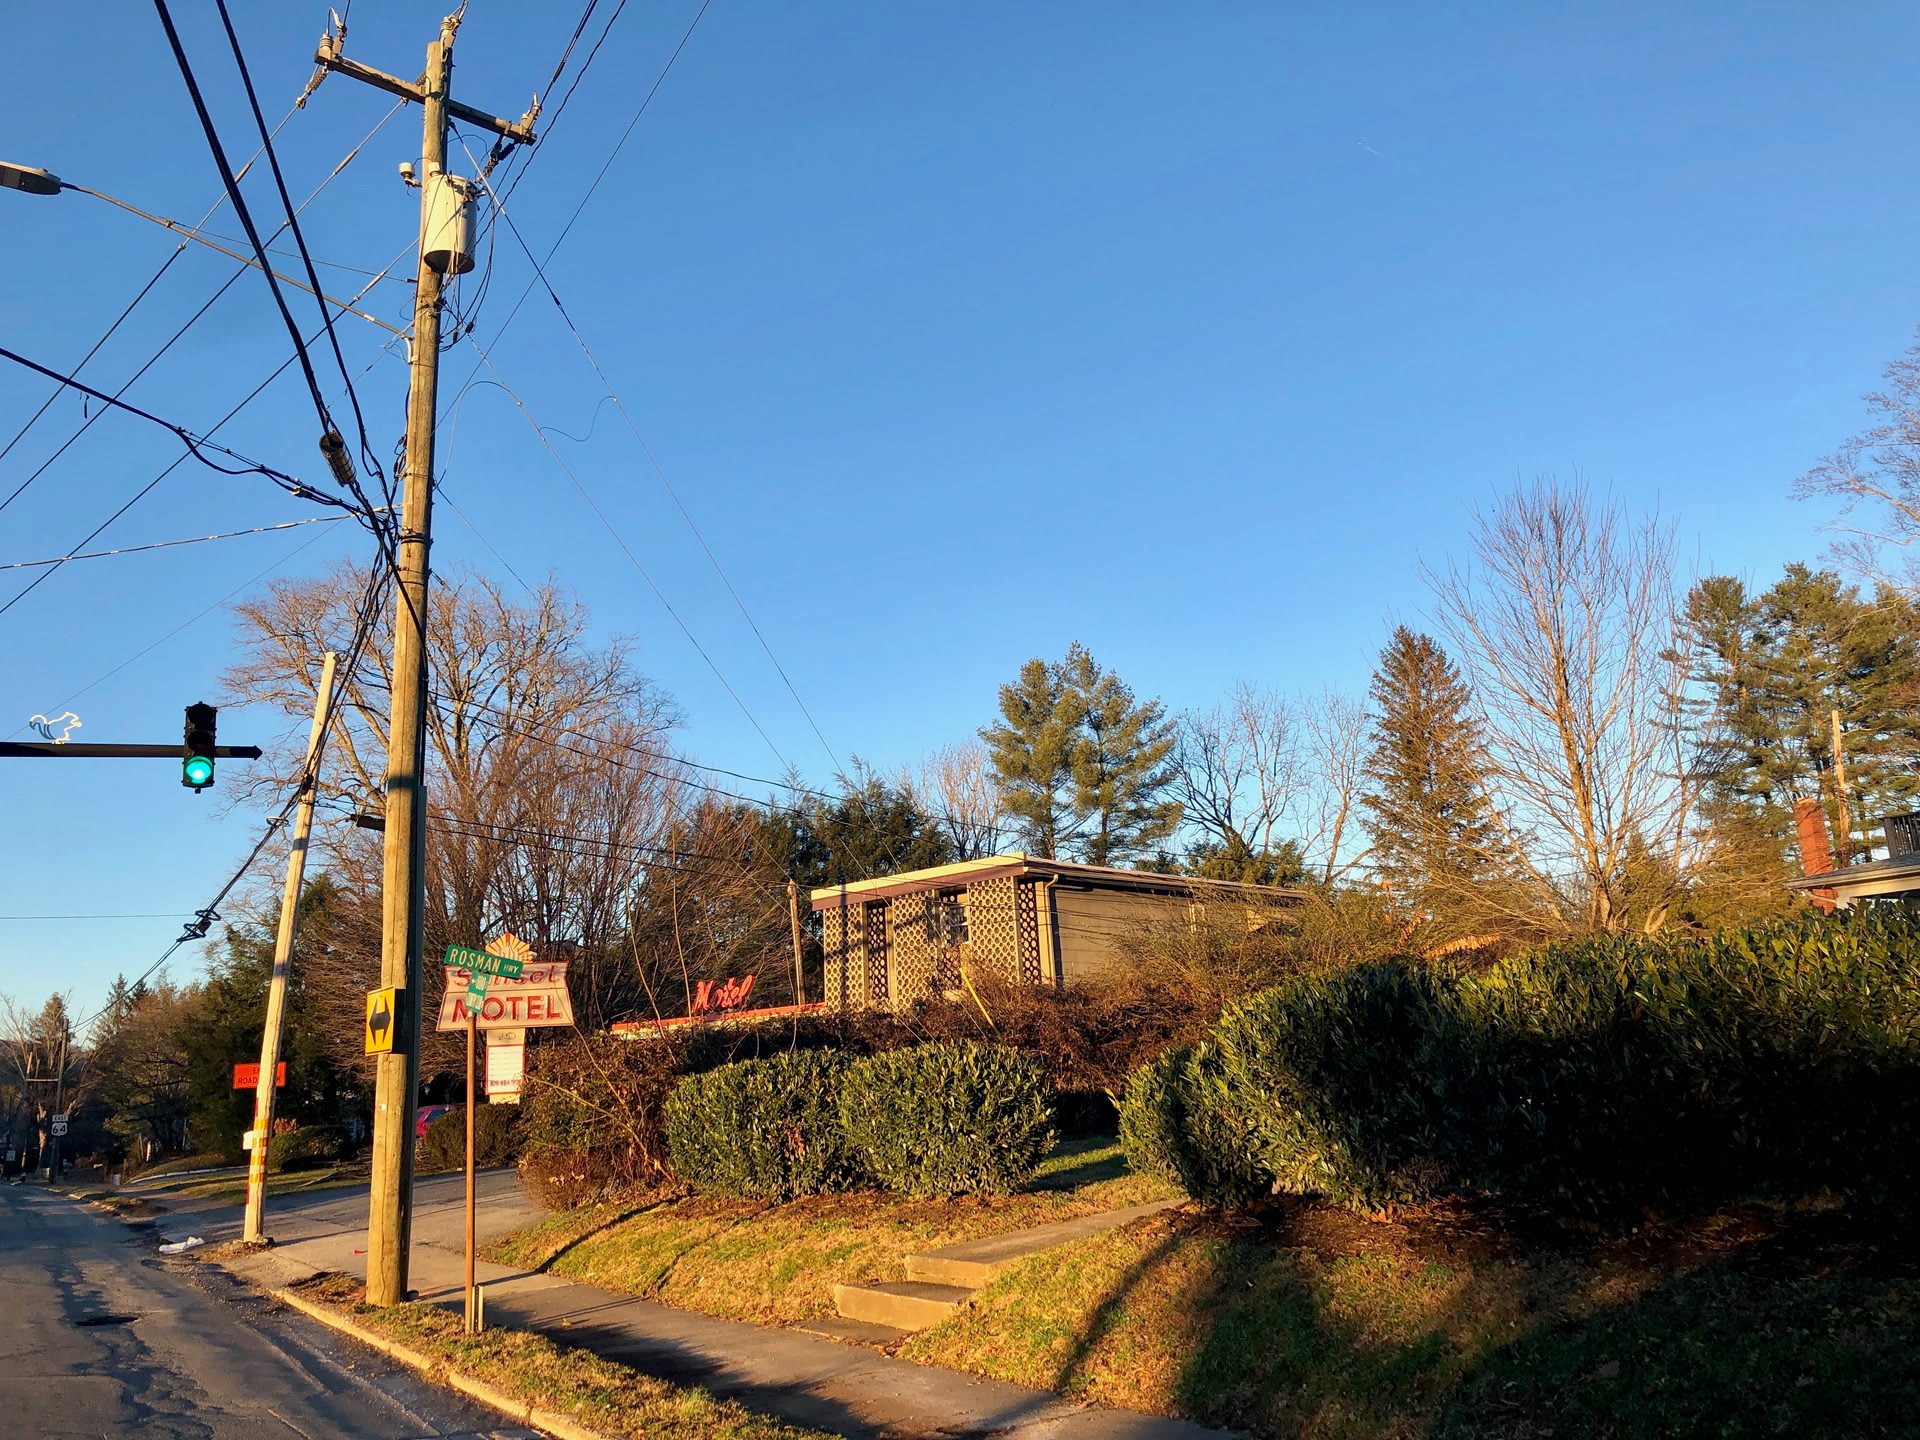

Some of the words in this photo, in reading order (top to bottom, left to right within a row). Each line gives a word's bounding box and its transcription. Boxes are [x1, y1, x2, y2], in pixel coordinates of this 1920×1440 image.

[449, 948, 501, 973] ROSMAN
[503, 963, 519, 974] HWY
[691, 975, 755, 1013] Motel
[237, 1077, 258, 1085] ROAD
[53, 1125, 66, 1134] 64
